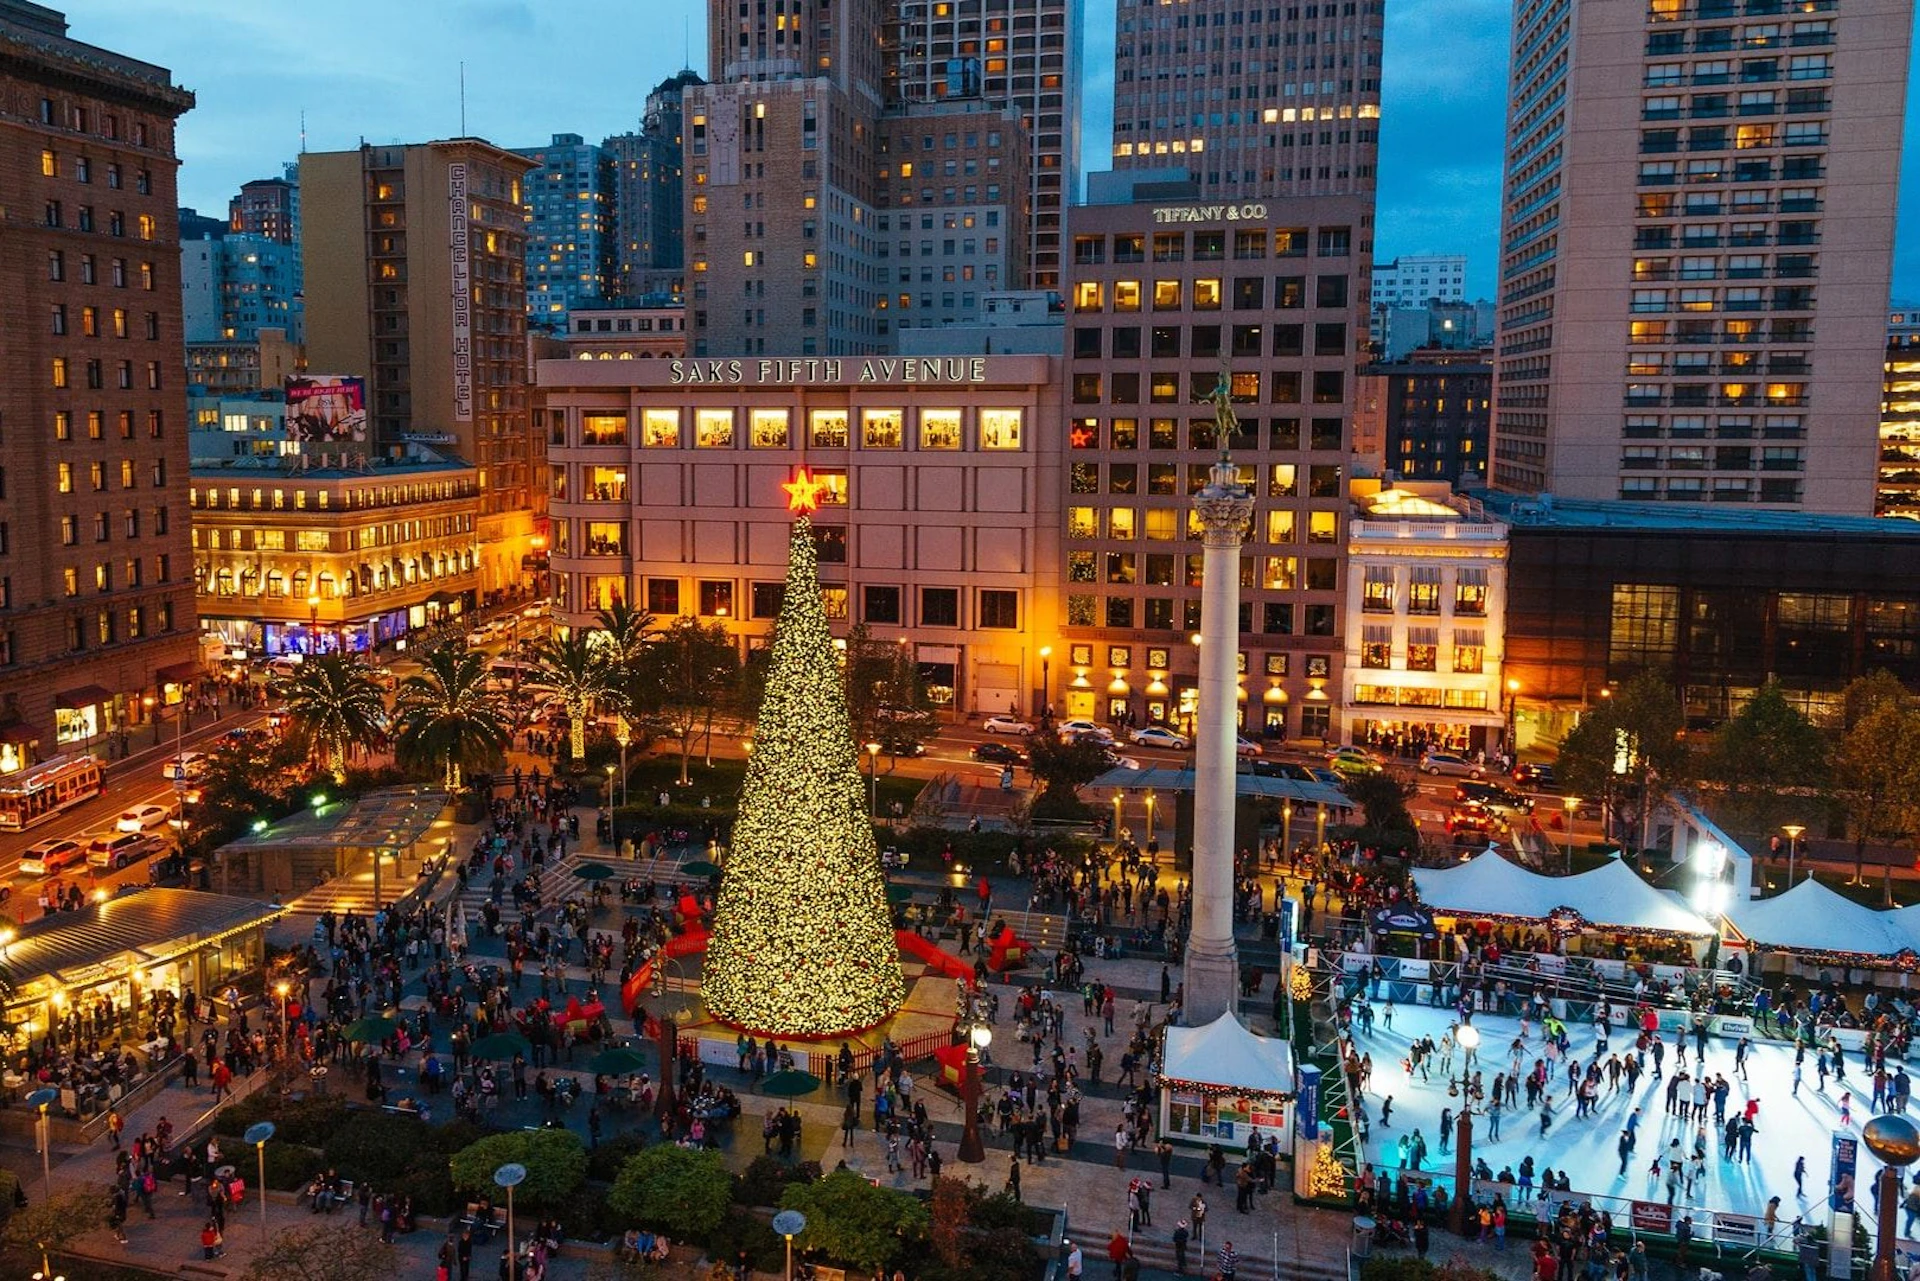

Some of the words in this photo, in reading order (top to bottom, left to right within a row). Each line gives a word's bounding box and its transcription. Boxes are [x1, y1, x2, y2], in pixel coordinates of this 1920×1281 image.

[1153, 206, 1225, 223] TIFFANY
[1226, 205, 1240, 221] &
[1240, 204, 1268, 220] CO.
[451, 165, 471, 327] CHANCELLOR
[455, 337, 470, 416] HOTEL
[669, 360, 743, 384] SAKS
[758, 360, 842, 383] FIFTH
[859, 358, 986, 383] AVENUE
[1723, 1023, 1748, 1033] thrive
